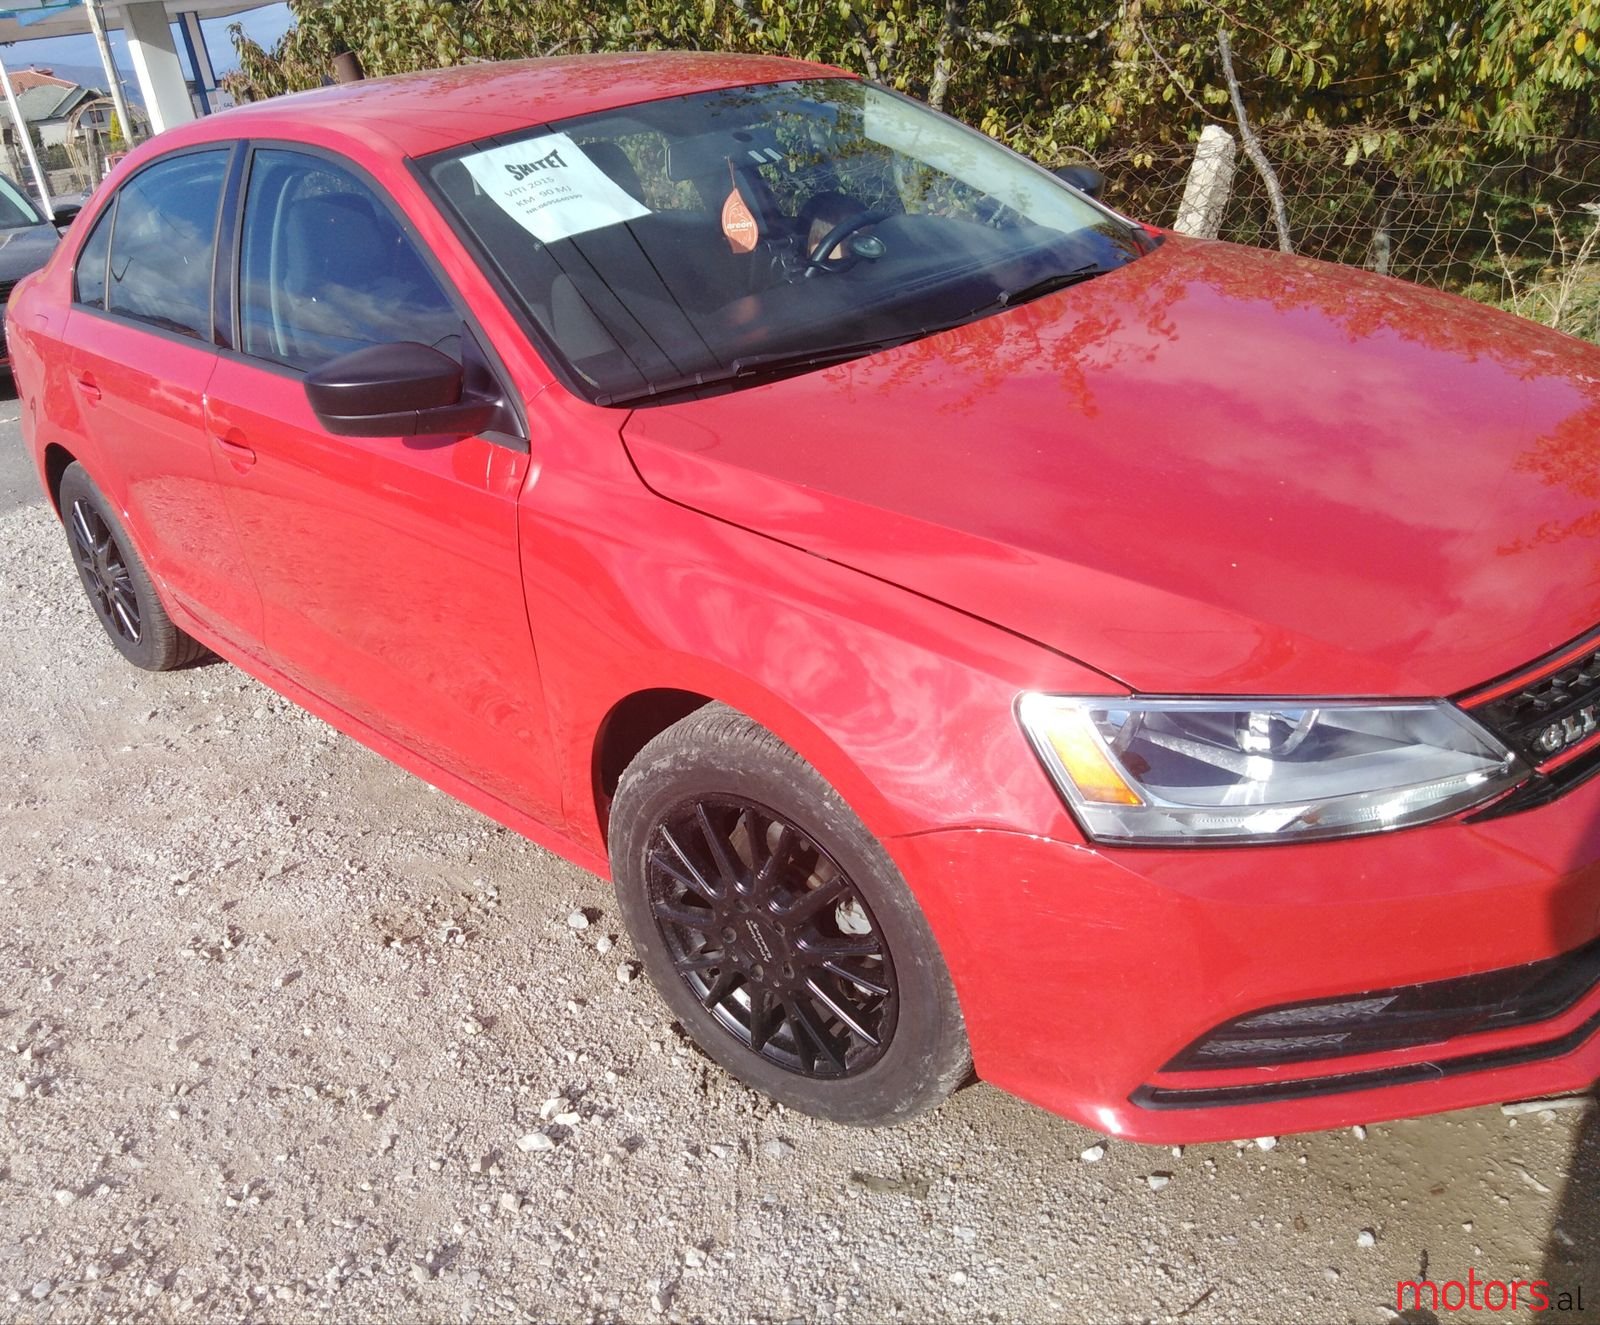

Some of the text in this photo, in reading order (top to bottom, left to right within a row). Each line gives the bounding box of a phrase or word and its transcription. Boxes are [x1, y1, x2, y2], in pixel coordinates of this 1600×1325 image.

[504, 149, 568, 181] SHITET
[504, 177, 554, 197] VITI 2015
[516, 196, 535, 207] KM
[539, 189, 554, 198] 90
[1540, 704, 1597, 752] GLI
